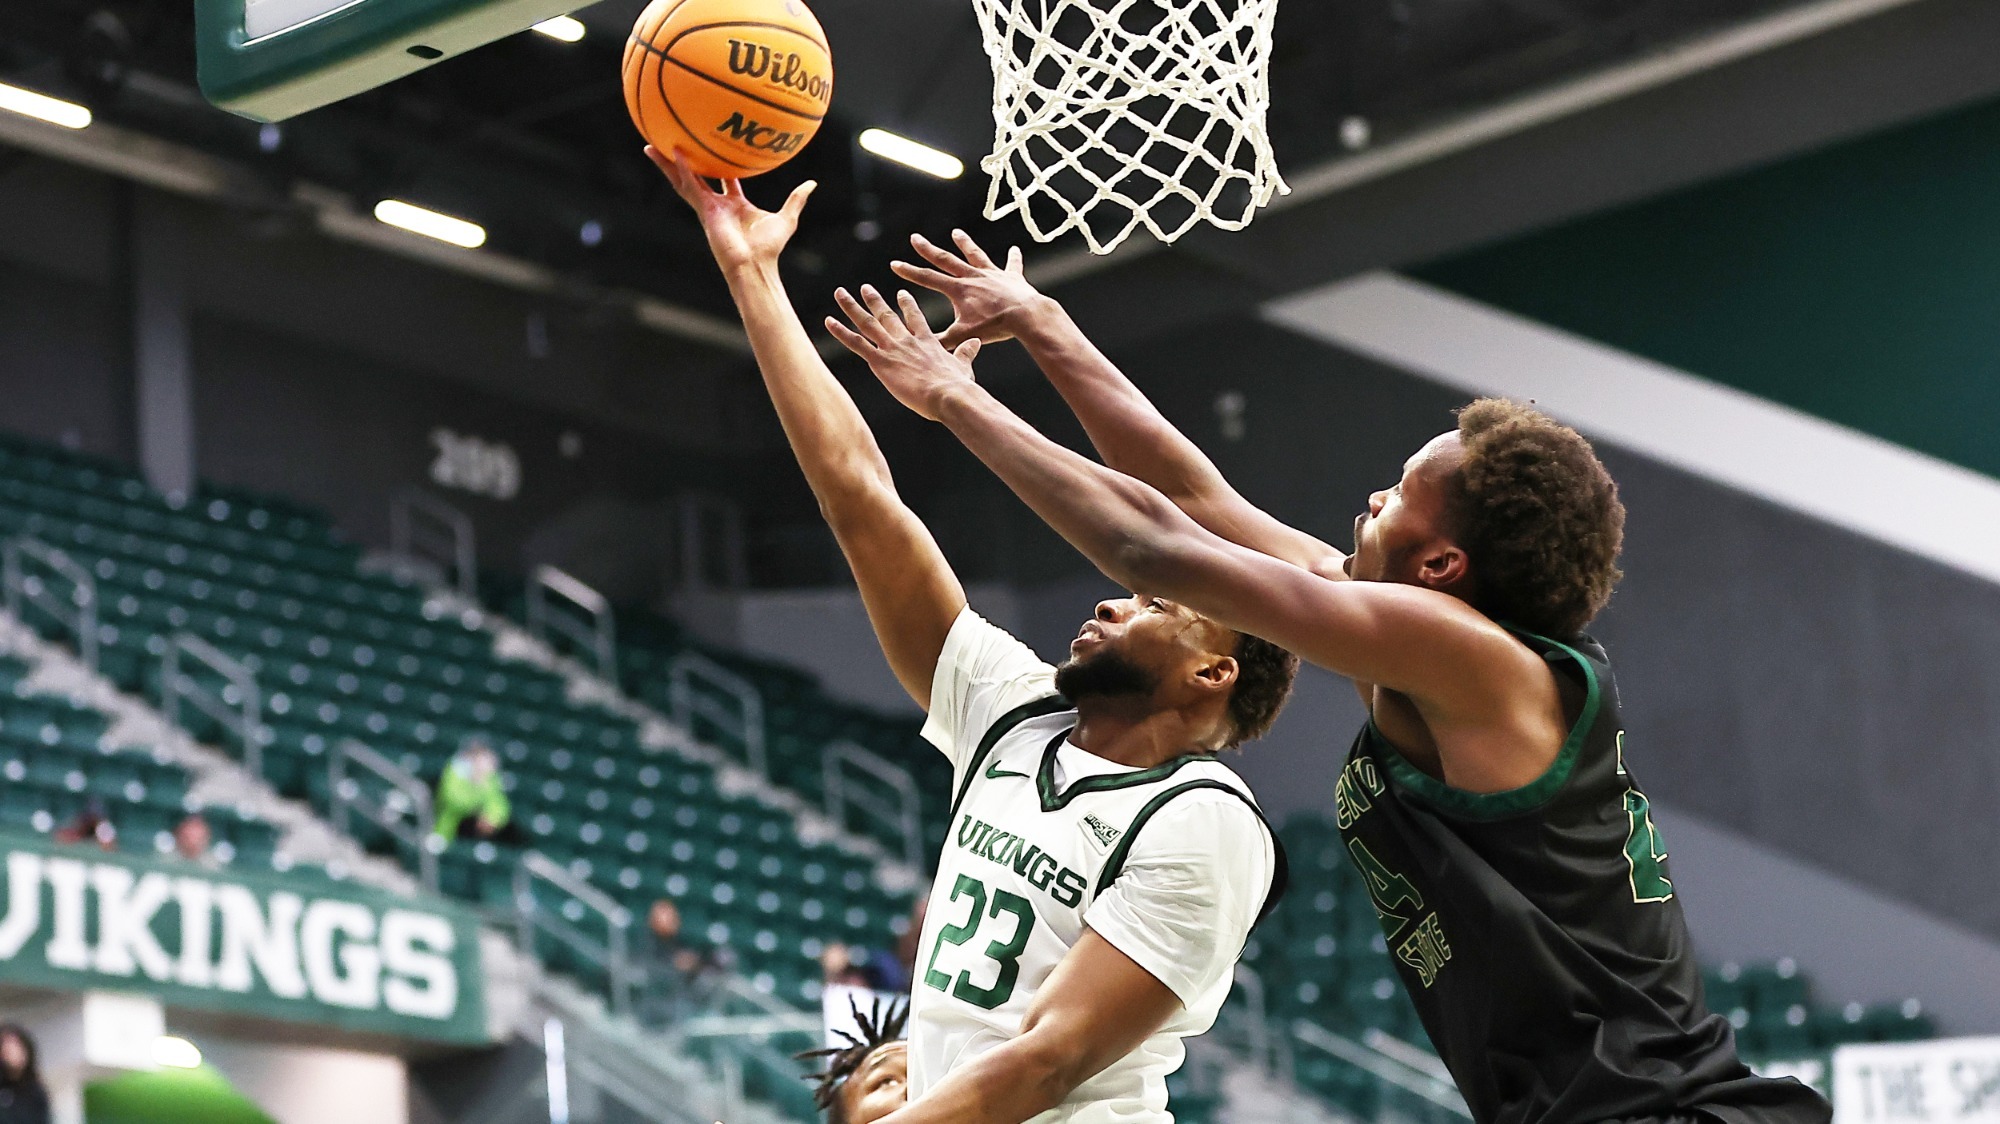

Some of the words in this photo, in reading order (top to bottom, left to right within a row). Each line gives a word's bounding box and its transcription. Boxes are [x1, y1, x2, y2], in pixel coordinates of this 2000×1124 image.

[727, 38, 831, 105] Wilson
[715, 111, 805, 154] NCAA
[957, 814, 1088, 909] VIKINGS
[1349, 837, 1424, 941] 4
[924, 873, 1036, 1010] 23
